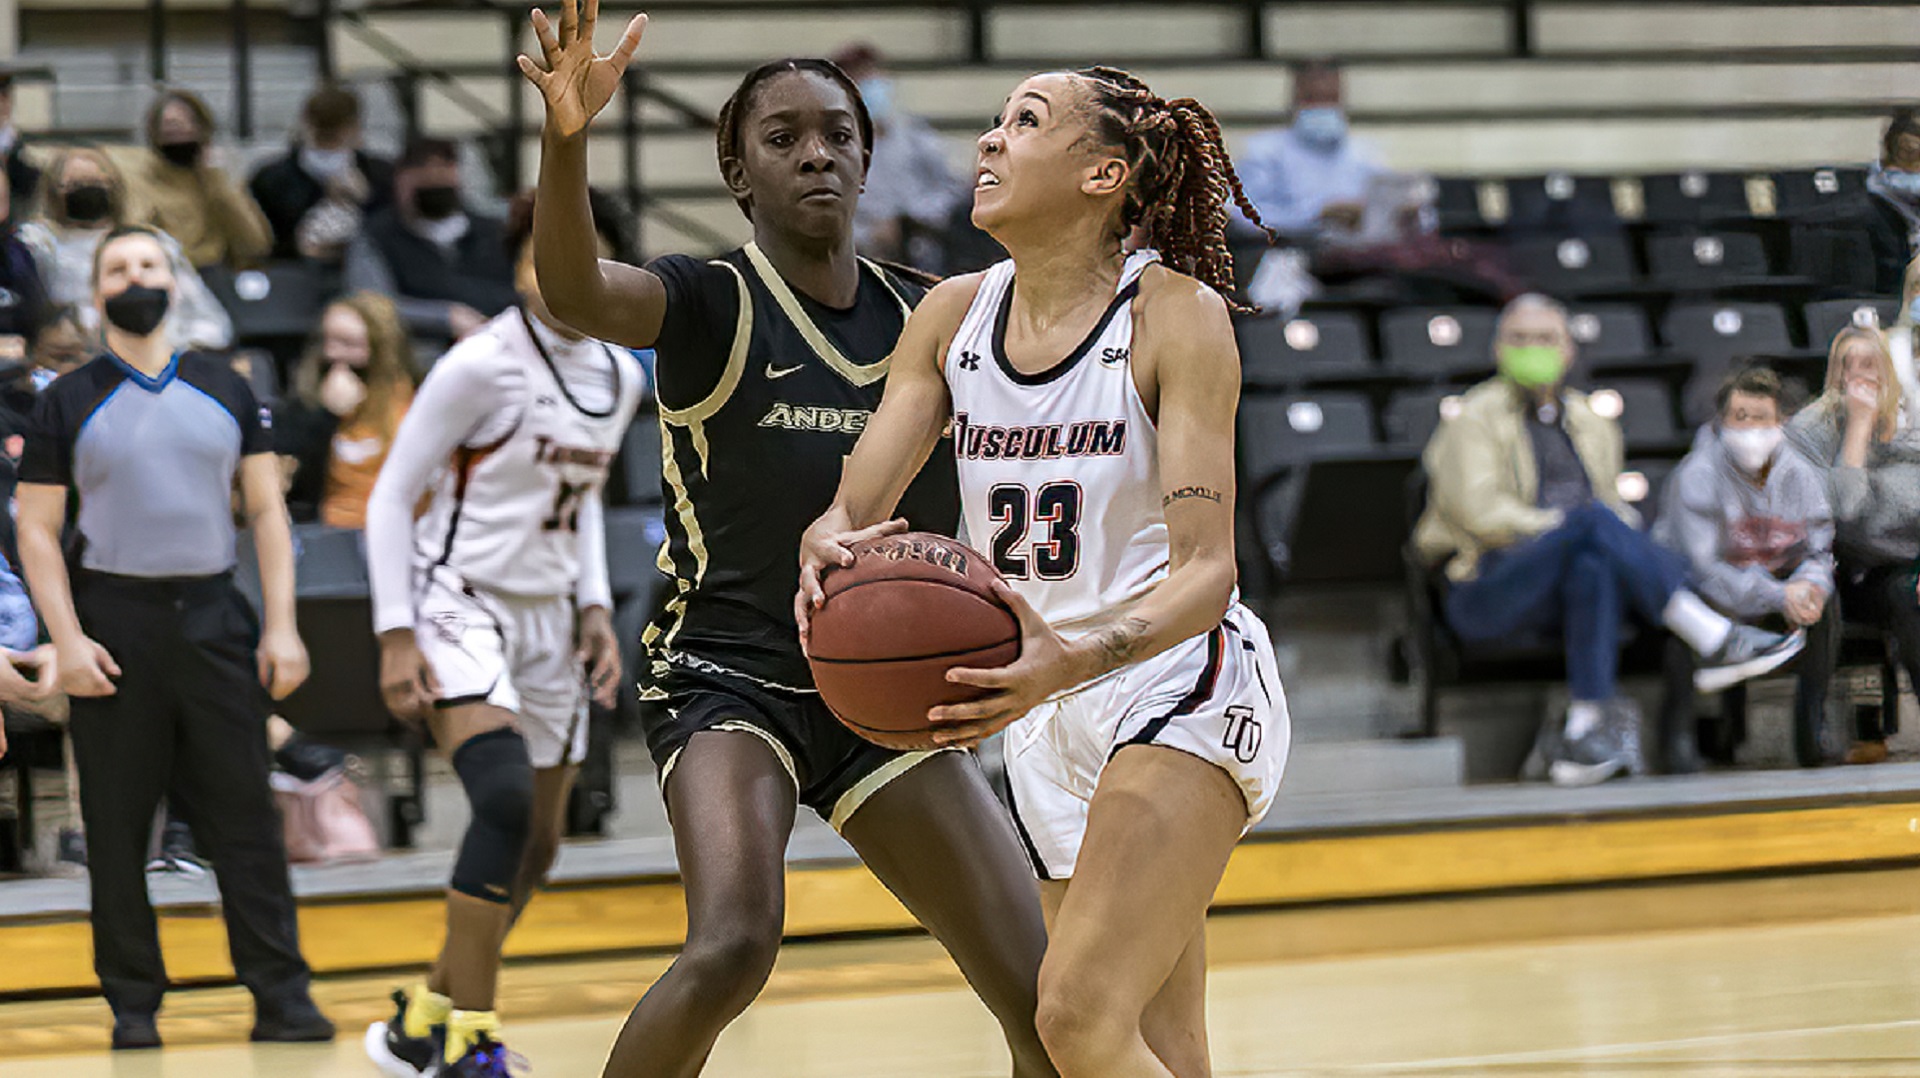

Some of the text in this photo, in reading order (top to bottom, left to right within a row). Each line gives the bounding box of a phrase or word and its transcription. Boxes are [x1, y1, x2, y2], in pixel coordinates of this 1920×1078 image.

[757, 402, 873, 433] ANDE
[988, 479, 1084, 582] 23
[1222, 705, 1262, 764] TU
